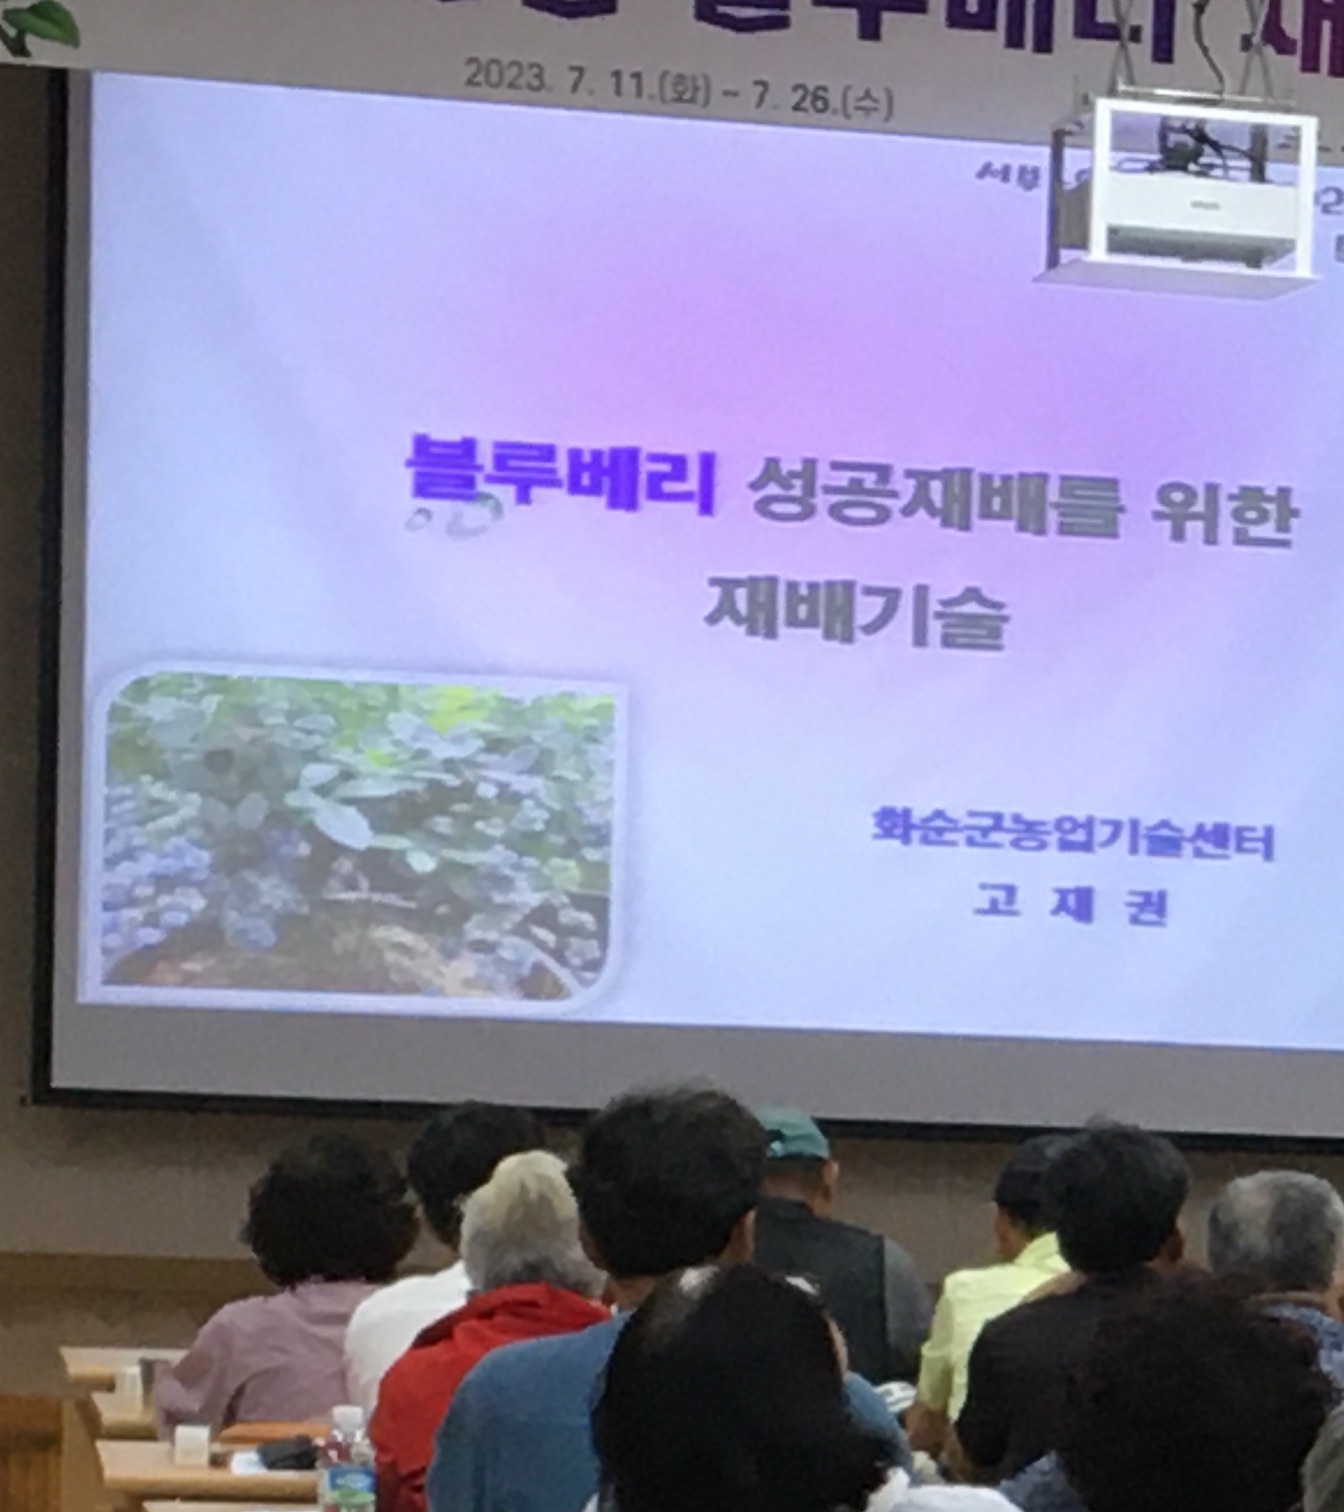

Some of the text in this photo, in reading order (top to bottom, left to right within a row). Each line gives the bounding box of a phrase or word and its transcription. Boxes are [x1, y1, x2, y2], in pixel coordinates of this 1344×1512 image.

[463, 57, 553, 93] 2023.
[405, 432, 1301, 549] 블루베리 성공재배를 위한
[703, 574, 1012, 652] 재배기술
[871, 805, 1276, 863] 화순군농업기술센터
